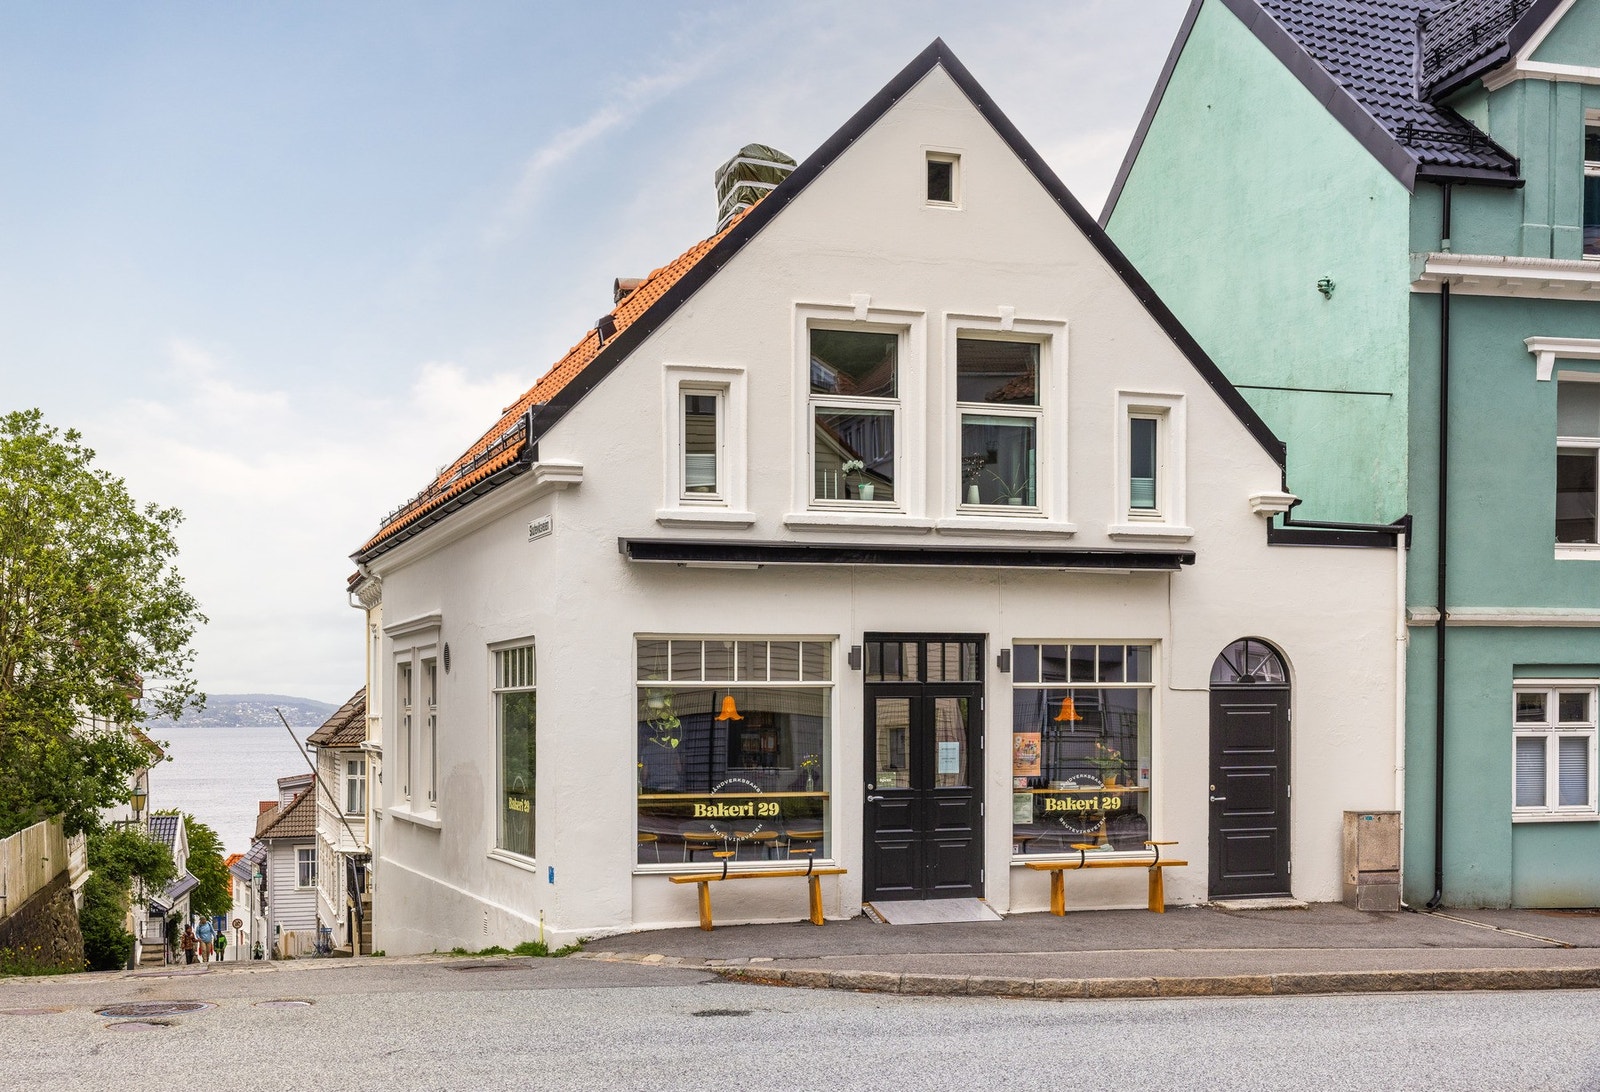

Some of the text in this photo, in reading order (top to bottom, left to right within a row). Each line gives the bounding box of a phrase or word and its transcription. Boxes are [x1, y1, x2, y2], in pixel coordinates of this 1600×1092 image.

[508, 797, 530, 813] Bakeri 29
[693, 801, 780, 817] Bakeri 29
[1045, 796, 1099, 811] Bakeri
[1101, 796, 1122, 810] 29
